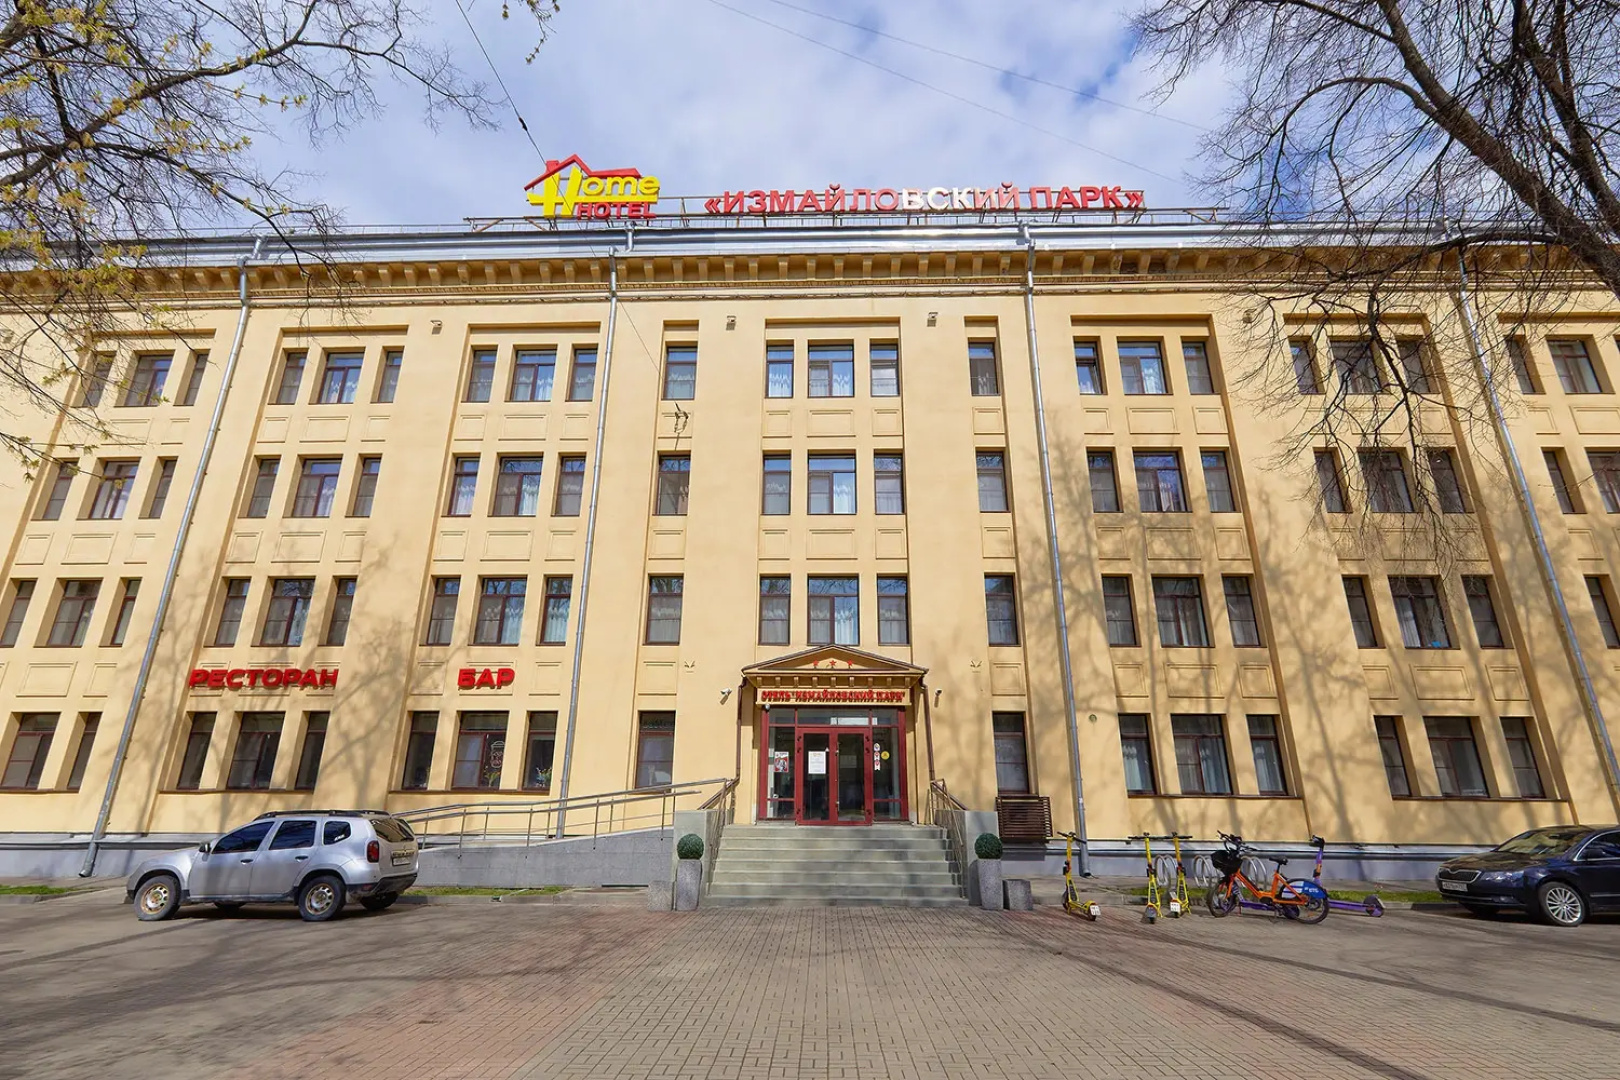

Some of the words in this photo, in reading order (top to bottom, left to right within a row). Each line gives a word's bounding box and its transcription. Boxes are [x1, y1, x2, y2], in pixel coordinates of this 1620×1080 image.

[526, 165, 660, 218] Home
[704, 181, 1020, 213] «ИЗМАЙЛОВСКИЙ
[1029, 186, 1144, 209] ПАРК»
[577, 202, 656, 220] HOTEL
[188, 668, 339, 690] РЕСТОРАН
[457, 668, 515, 690] БАР
